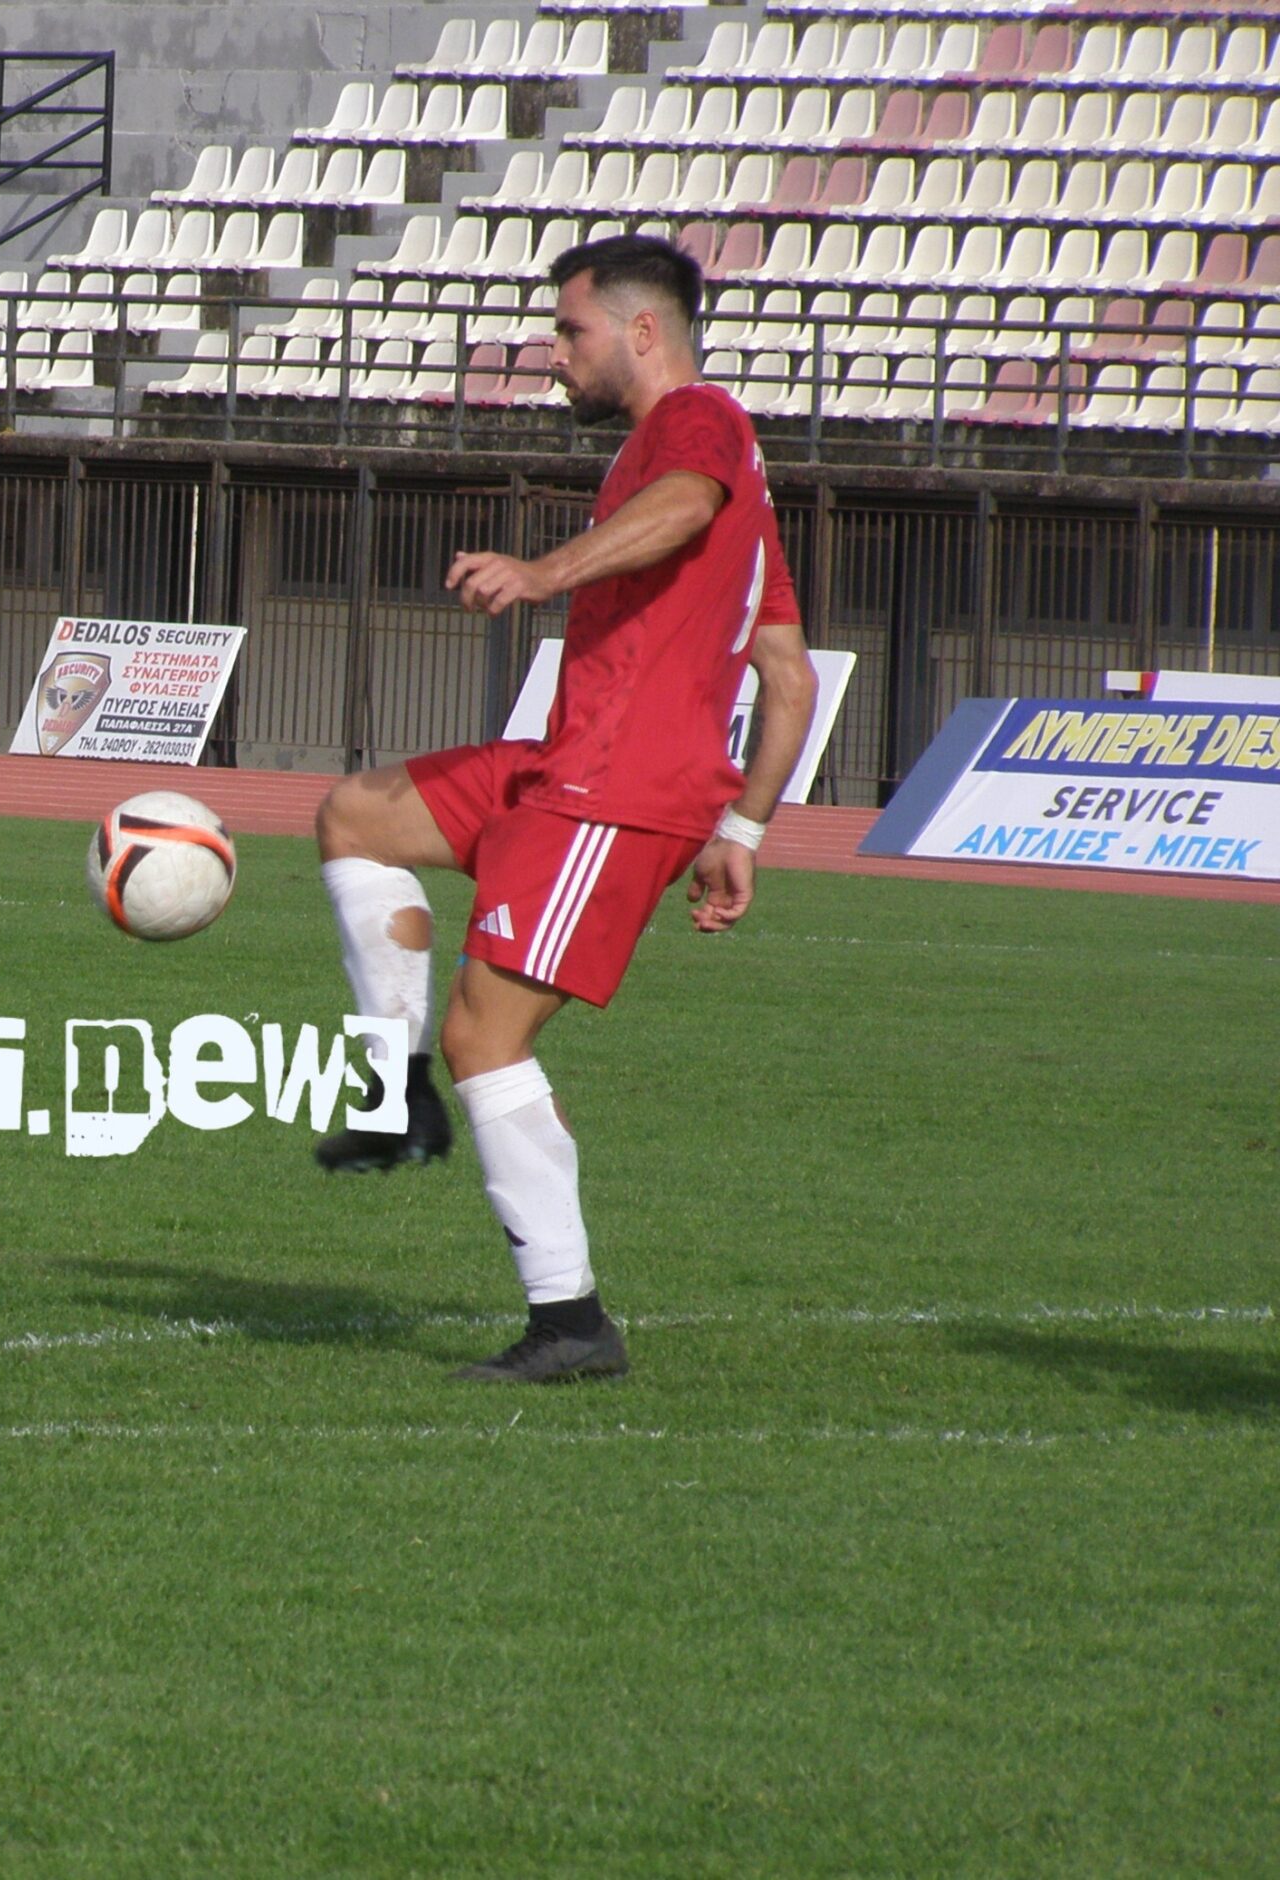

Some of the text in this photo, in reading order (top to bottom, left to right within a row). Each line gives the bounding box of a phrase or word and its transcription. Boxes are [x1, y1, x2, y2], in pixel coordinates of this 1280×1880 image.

[58, 620, 233, 647] DEDALOS SECURITY
[132, 651, 219, 668] ΣΥΣΤΗΜΑΤΑ
[57, 663, 101, 680] SECURITY
[122, 666, 221, 683] ΣΥΝΑΓΕΡΜΟΥ
[129, 683, 203, 698] ΦΥΛΑΞΕΙΣ
[102, 697, 210, 718] ΠΥΡΓΟΣ ΗΛΕΙΑΣ
[100, 718, 171, 733] ΠΑΠΑΦΛΕΣΣΑ
[1001, 709, 1280, 771] ΛΥΜΠΕΡΗΣ DIES
[1043, 786, 1223, 825] SERVICE
[954, 824, 1121, 862] ΑΝΤΛΙΕΣ
[1144, 833, 1262, 871] ΜΠΕΚ
